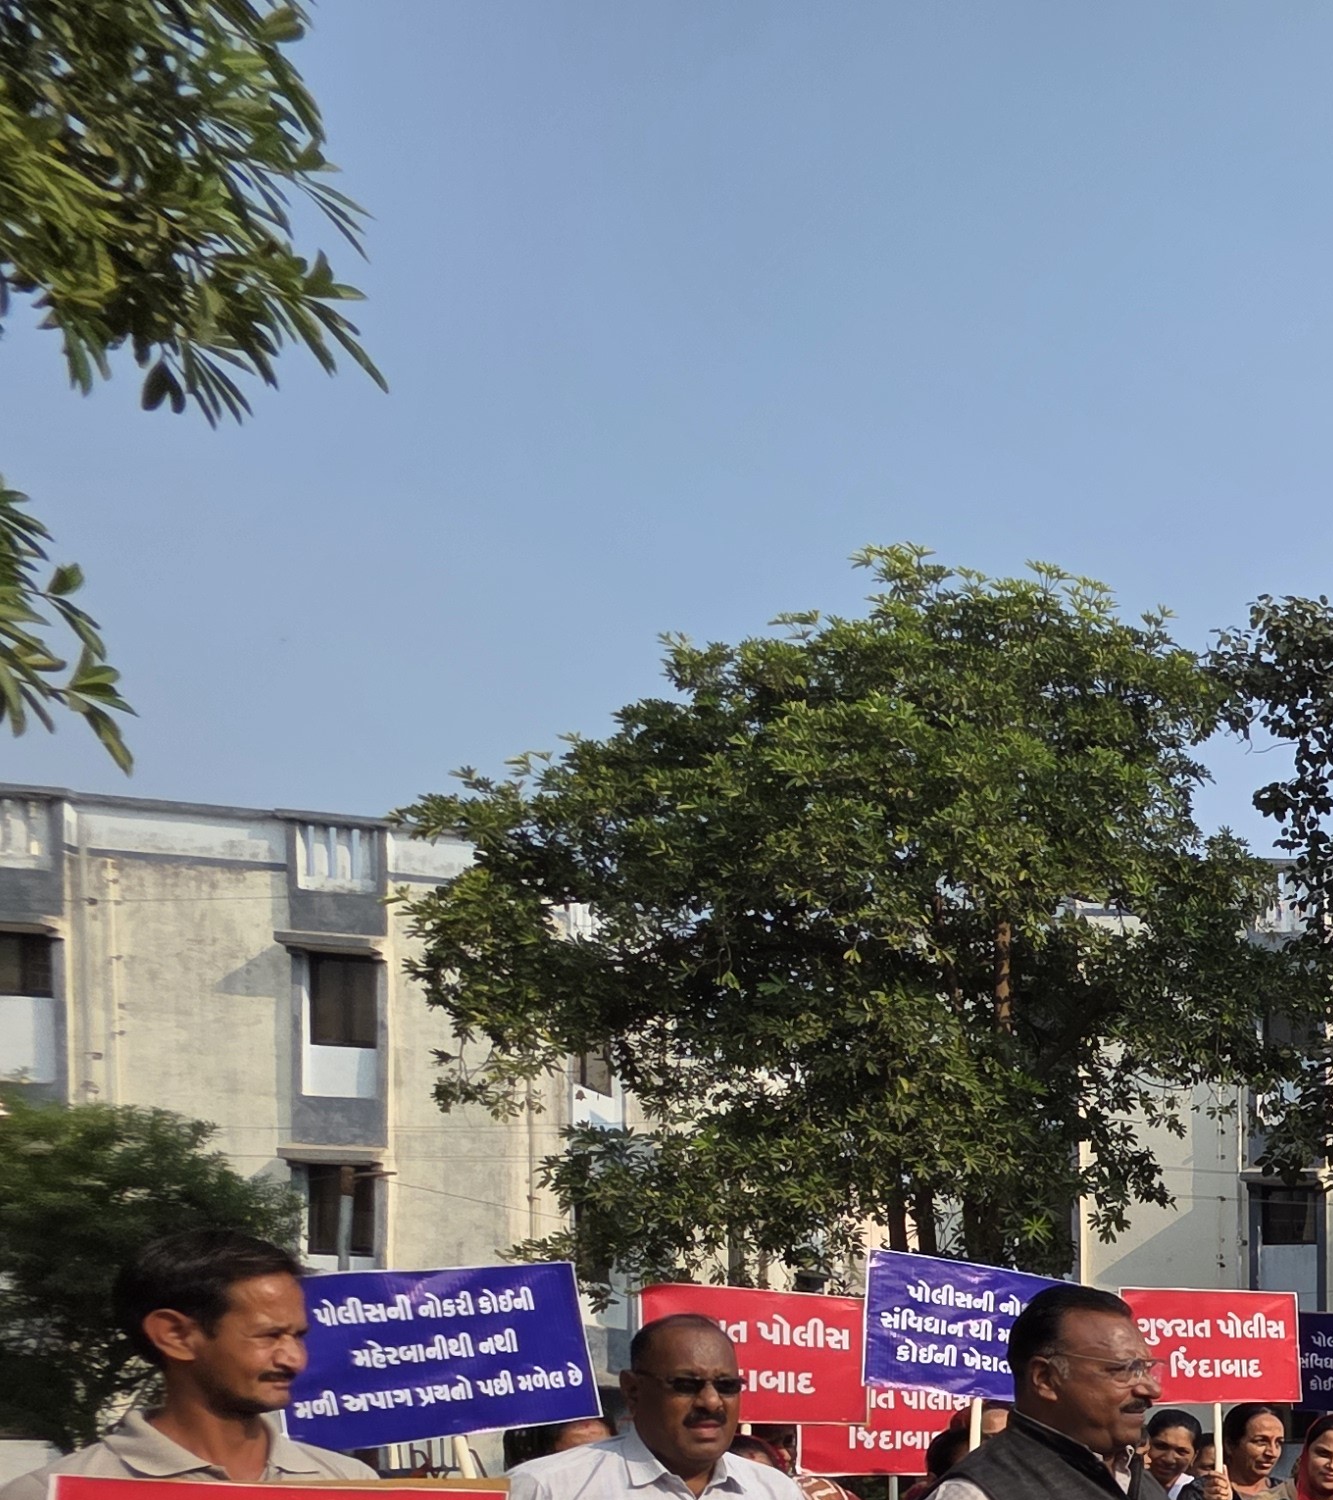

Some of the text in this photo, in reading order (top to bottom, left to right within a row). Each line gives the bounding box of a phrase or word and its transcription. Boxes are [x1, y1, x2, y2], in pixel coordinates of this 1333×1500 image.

[313, 1286, 535, 1326] પોલીસની નોકરી કોઈની
[906, 1279, 994, 1312] પોલીસની
[756, 1314, 850, 1350] પોલીસ
[879, 1306, 964, 1338] સંવિધાન
[968, 1318, 994, 1342] થી
[1137, 1312, 1285, 1346] ગુજરાત પોલીસ
[351, 1328, 518, 1369] મહેરબાનીથી નથી
[896, 1337, 957, 1367] કોઈની
[1170, 1346, 1263, 1378] જિંદાબાદ
[293, 1390, 339, 1419] મળી
[476, 1370, 515, 1397] પછી
[517, 1366, 565, 1391] મળેલ
[567, 1362, 583, 1386] છે
